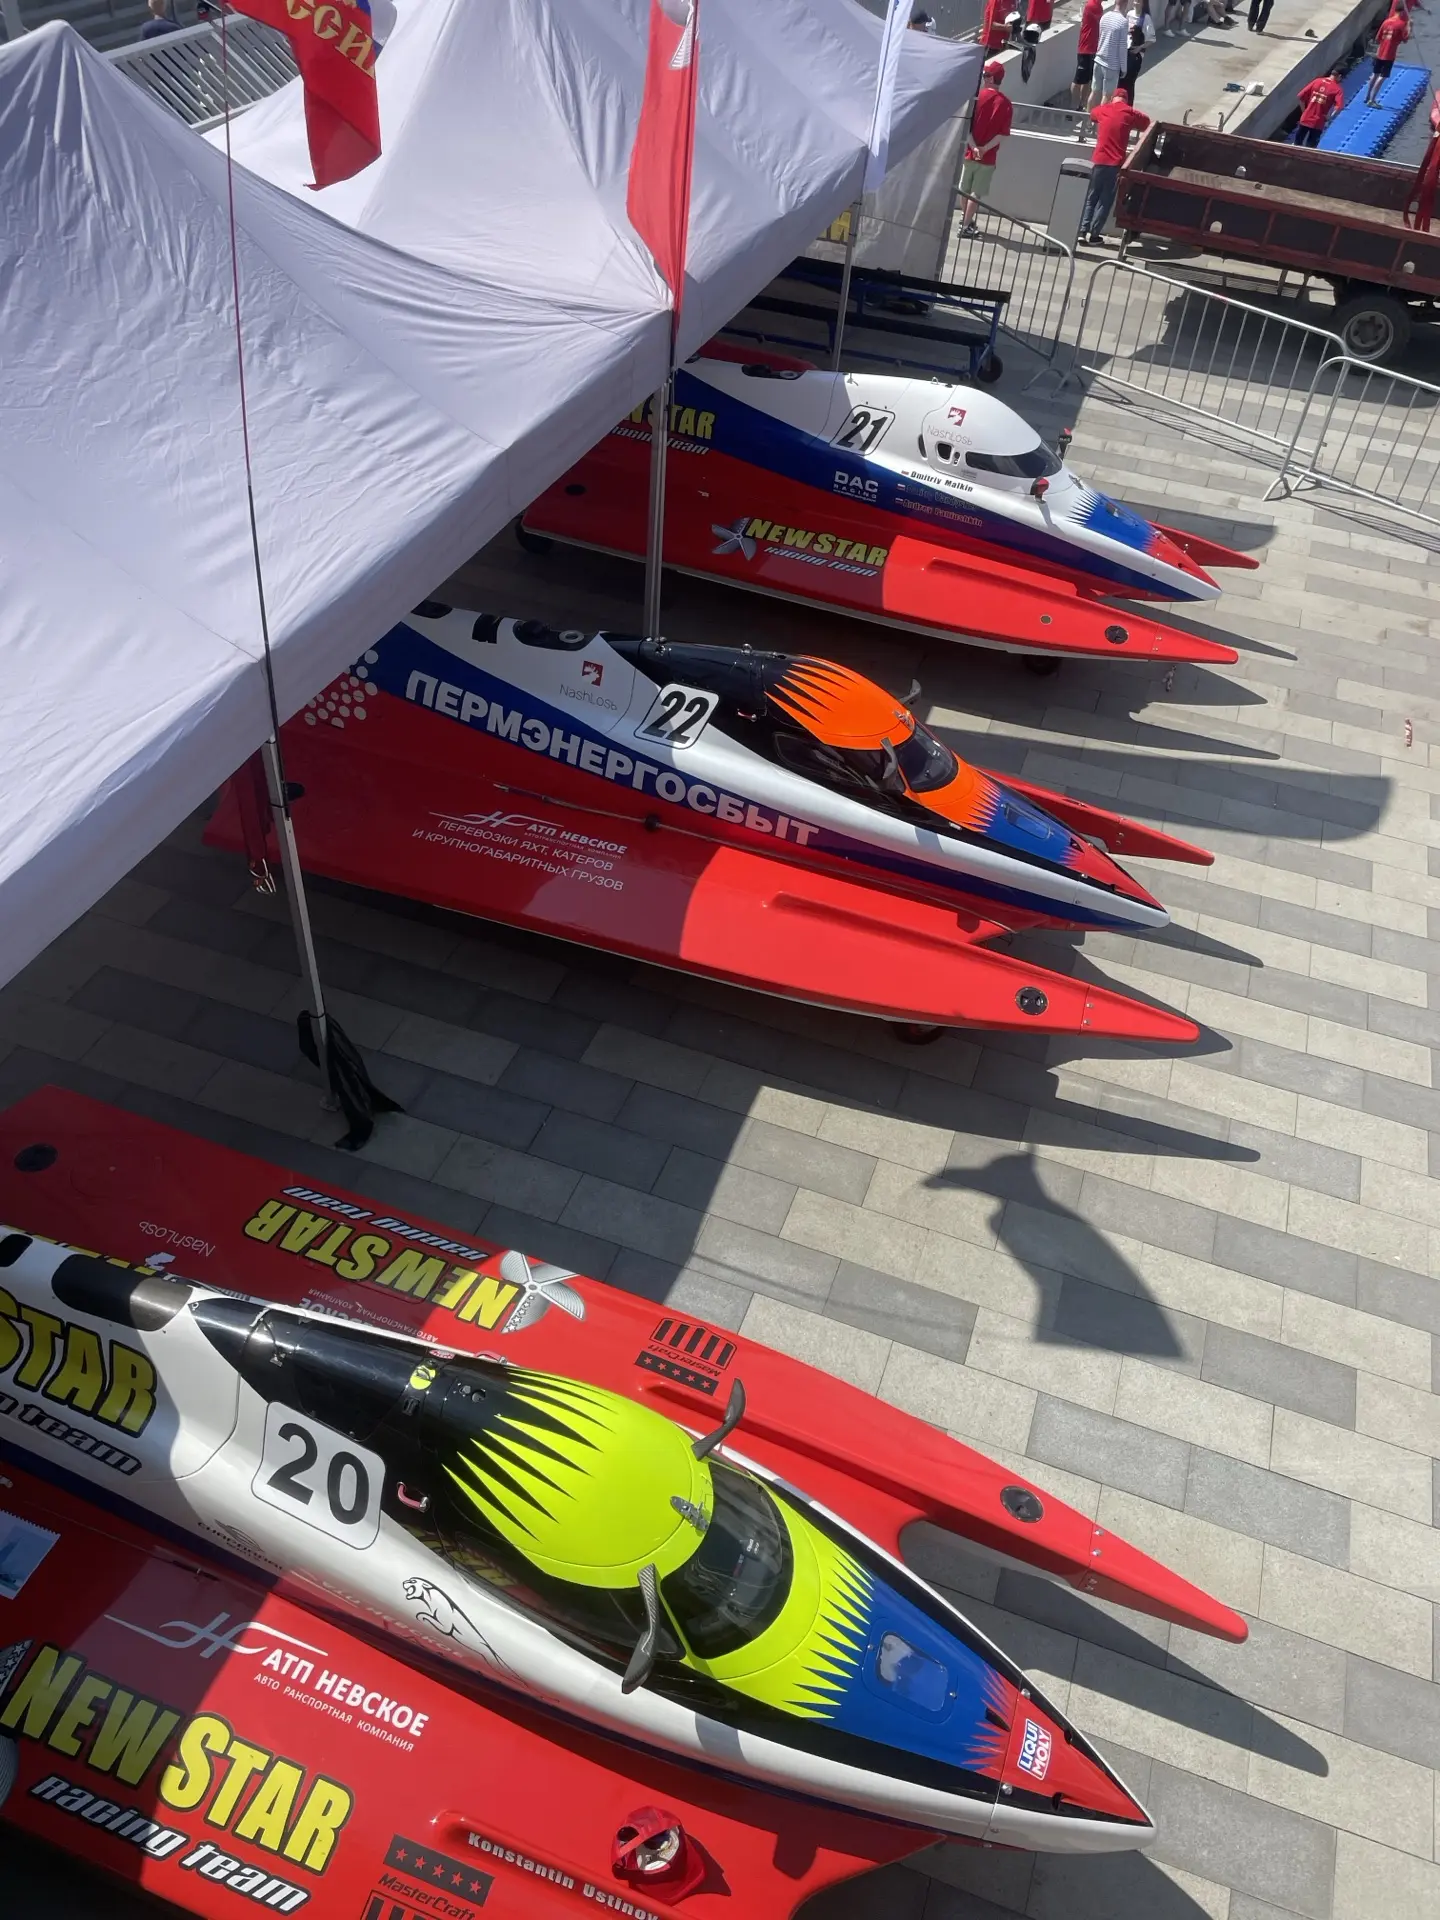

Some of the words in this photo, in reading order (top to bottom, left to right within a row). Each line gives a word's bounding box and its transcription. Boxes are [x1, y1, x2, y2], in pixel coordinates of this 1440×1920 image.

[836, 410, 888, 452] 21
[833, 483, 877, 499] RACING
[834, 470, 879, 493] DAC
[910, 470, 942, 485] Dmitriy
[944, 479, 974, 493] Malkin
[745, 518, 815, 550] NEW
[813, 533, 889, 567] STAR
[828, 561, 878, 577] team
[646, 689, 710, 744] 22
[405, 670, 820, 847] ПЕРМЭНЕРГОСБЫТ
[411, 828, 423, 838] И
[424, 831, 568, 877] КРУПНОГАБАРИТНЫХ
[571, 868, 625, 892] ГРУЗОВ
[437, 820, 519, 848] ПЕРЕВОЗКИ
[519, 841, 549, 856] ЯХТ,
[551, 849, 614, 872] КАТЕРОВ
[527, 823, 557, 837] АТП
[559, 831, 628, 855] НЕВСКОЕ
[282, 1185, 375, 1222] team
[242, 1199, 392, 1283] STAR
[376, 1246, 520, 1330] NEW
[647, 1343, 722, 1377] MasterCraft
[17, 1403, 143, 1476] team
[266, 1422, 370, 1526] 20
[263, 1648, 315, 1684] АТП
[314, 1669, 430, 1737] НЕВСКОЕ
[0, 1643, 184, 1789] NEW
[158, 1711, 355, 1877] STAR
[356, 1719, 415, 1752] КОМПАНИЯ
[1020, 1722, 1038, 1770] LIQUI
[1032, 1729, 1050, 1776] MOLY
[178, 1840, 312, 1915] team
[377, 1873, 476, 1920] MasterCraft
[467, 1830, 575, 1890] Konstantin
[582, 1879, 660, 1920] Ustinov
